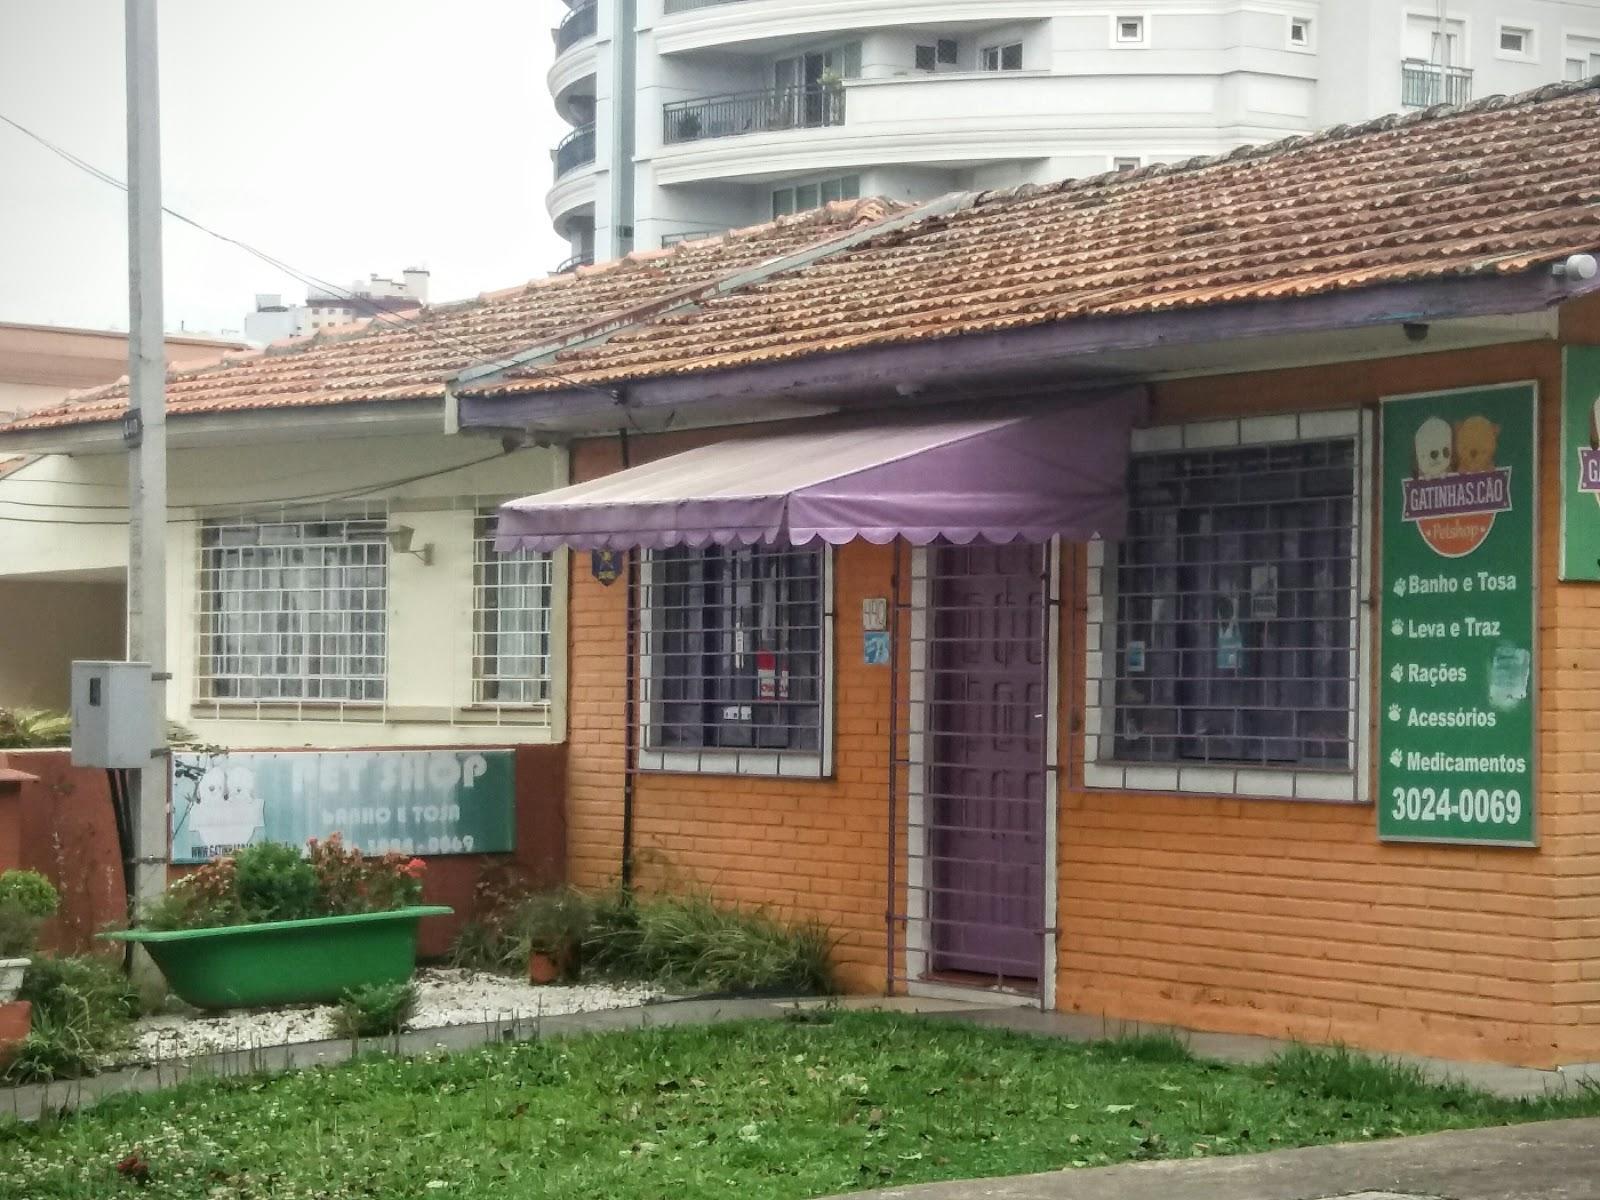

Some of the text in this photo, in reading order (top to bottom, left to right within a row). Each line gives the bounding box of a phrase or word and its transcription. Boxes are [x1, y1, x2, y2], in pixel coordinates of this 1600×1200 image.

[1408, 571, 1517, 594] Banho e Tosa
[1408, 617, 1501, 638] Leva e Traz
[1408, 663, 1467, 687] Rações
[1407, 706, 1497, 727] Acessórios
[378, 753, 488, 792] SHOP
[1407, 751, 1526, 773] Medicamentos
[1391, 786, 1521, 825] 3024-0069
